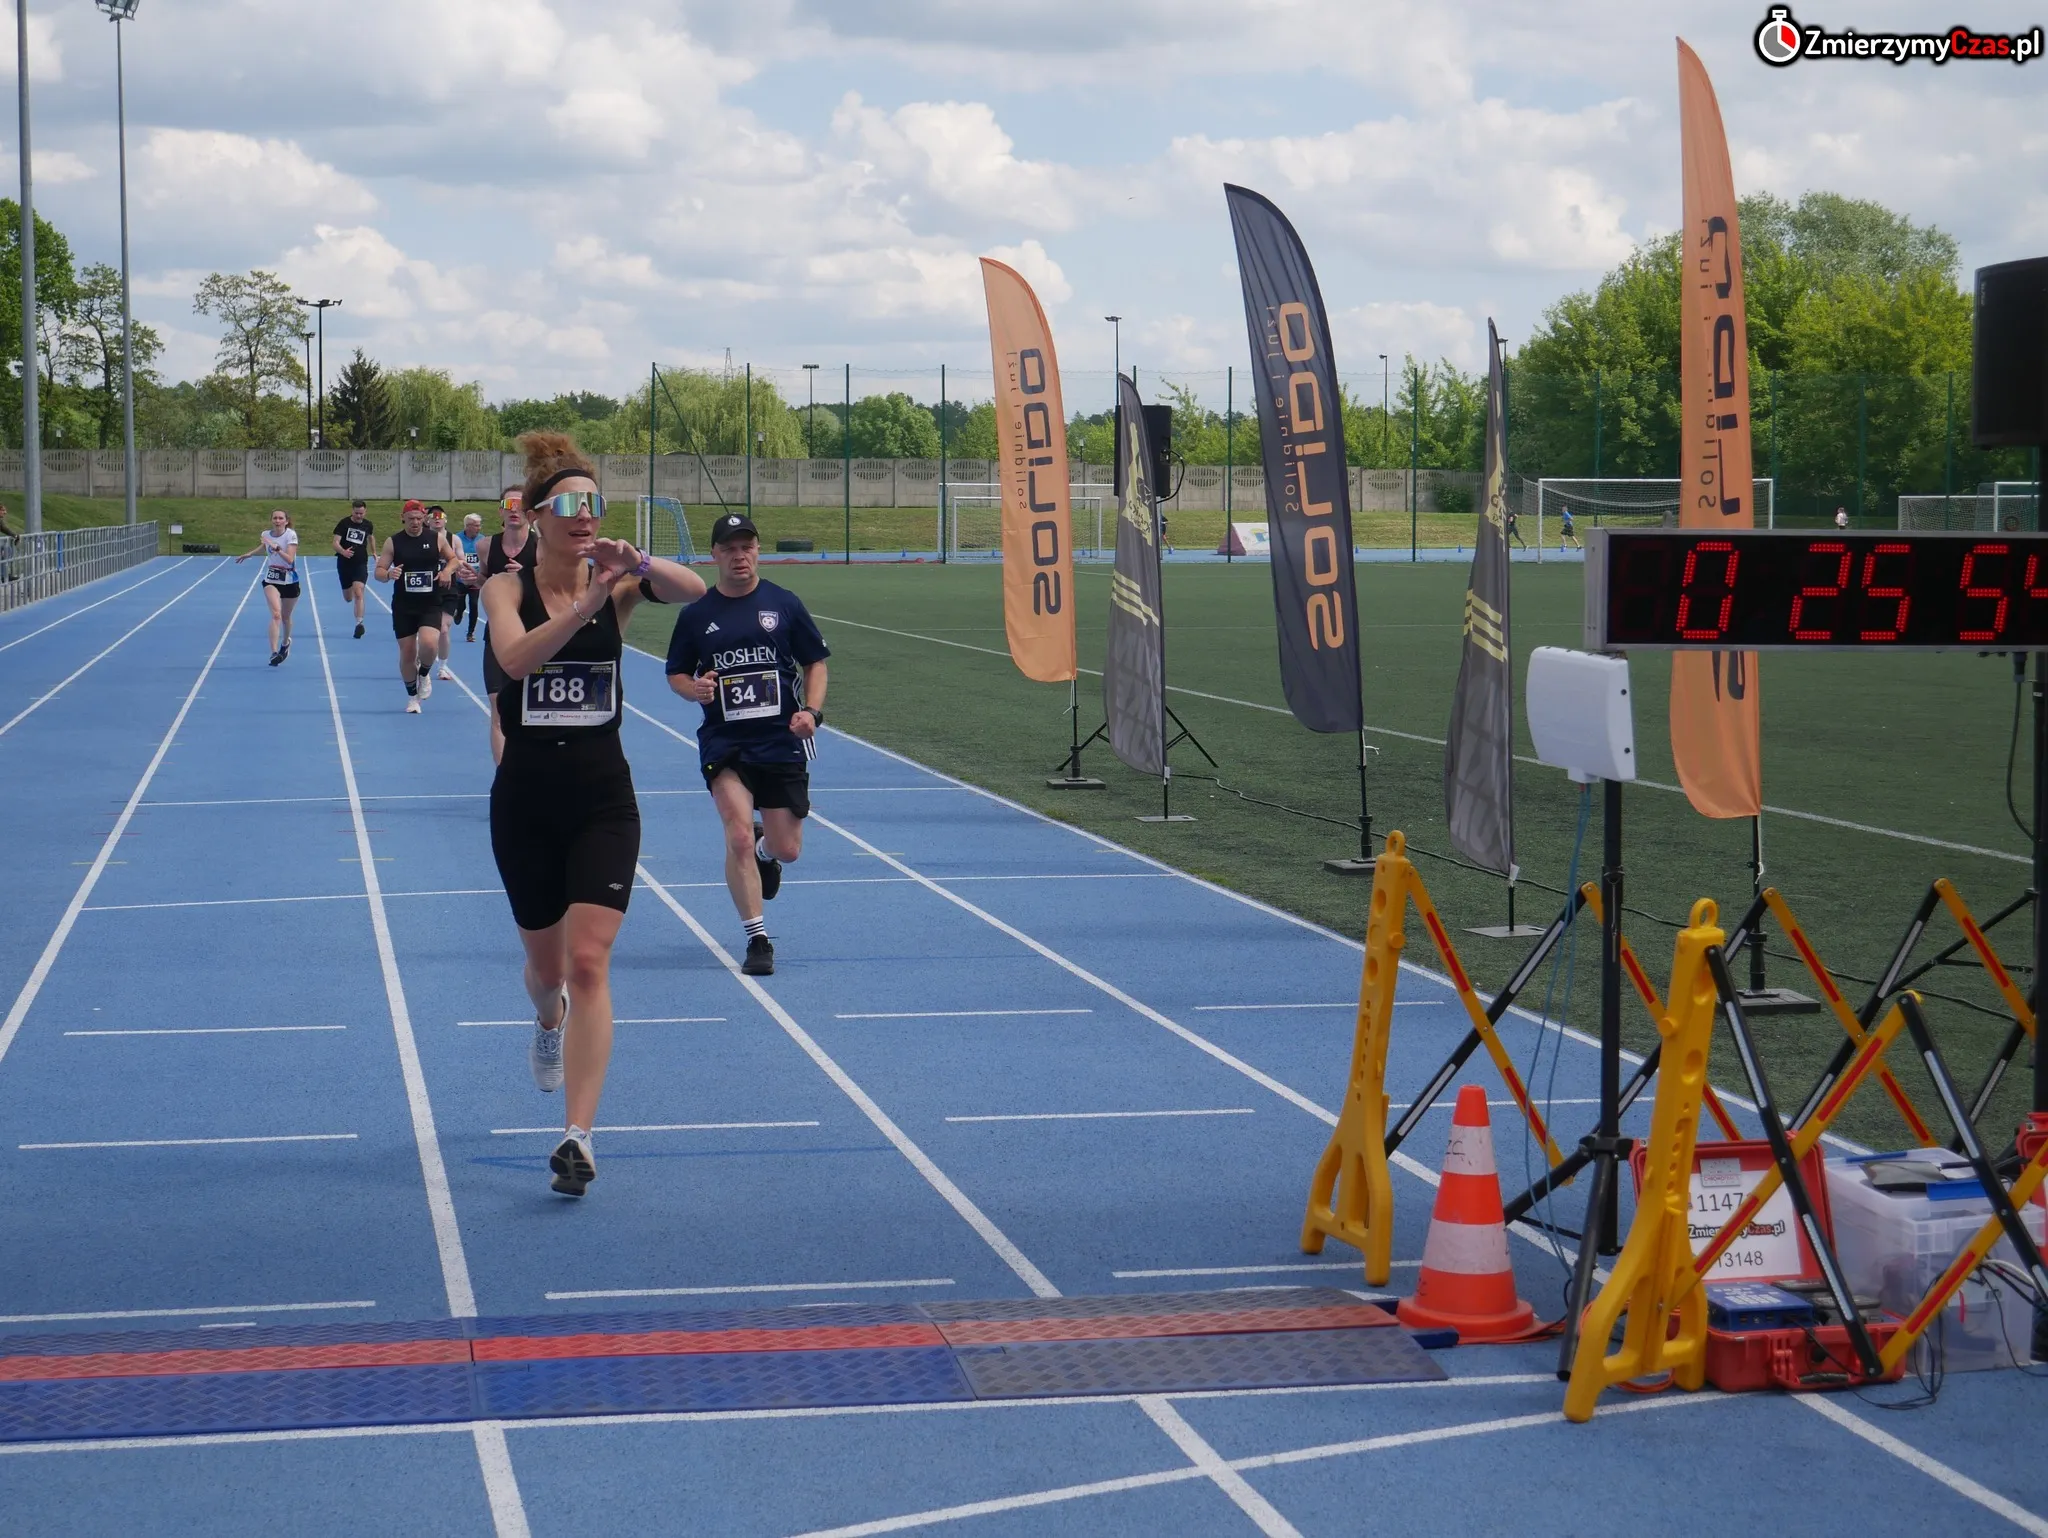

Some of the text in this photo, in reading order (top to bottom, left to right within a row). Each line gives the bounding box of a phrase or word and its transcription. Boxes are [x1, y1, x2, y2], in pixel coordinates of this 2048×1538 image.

[409, 577, 422, 586] 65
[1675, 541, 1740, 640] 0
[1788, 543, 1912, 641] 25
[712, 646, 777, 669] ROSHEN
[532, 677, 585, 703] 188
[731, 684, 757, 705] 34
